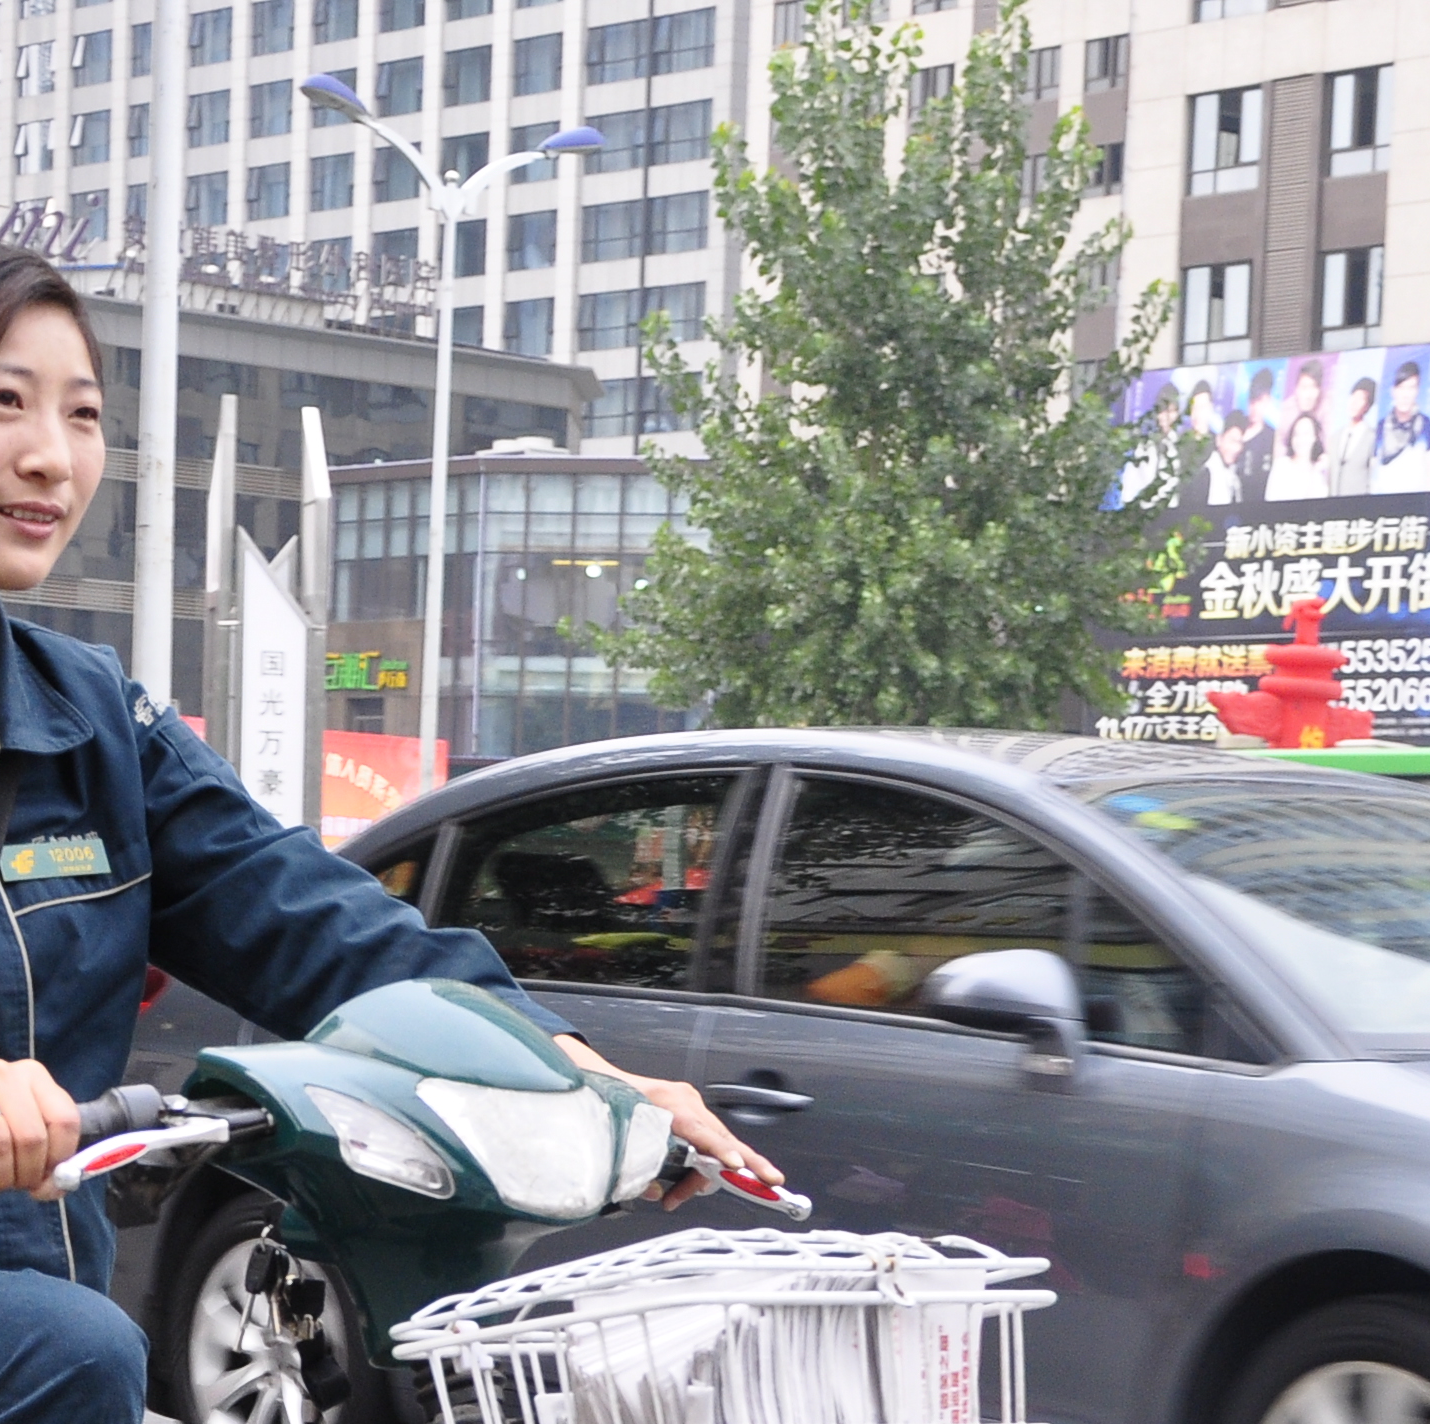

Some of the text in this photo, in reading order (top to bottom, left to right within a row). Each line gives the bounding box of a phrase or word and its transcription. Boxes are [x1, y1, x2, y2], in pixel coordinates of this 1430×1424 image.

[1224, 515, 1429, 560] 新小资主题步行街
